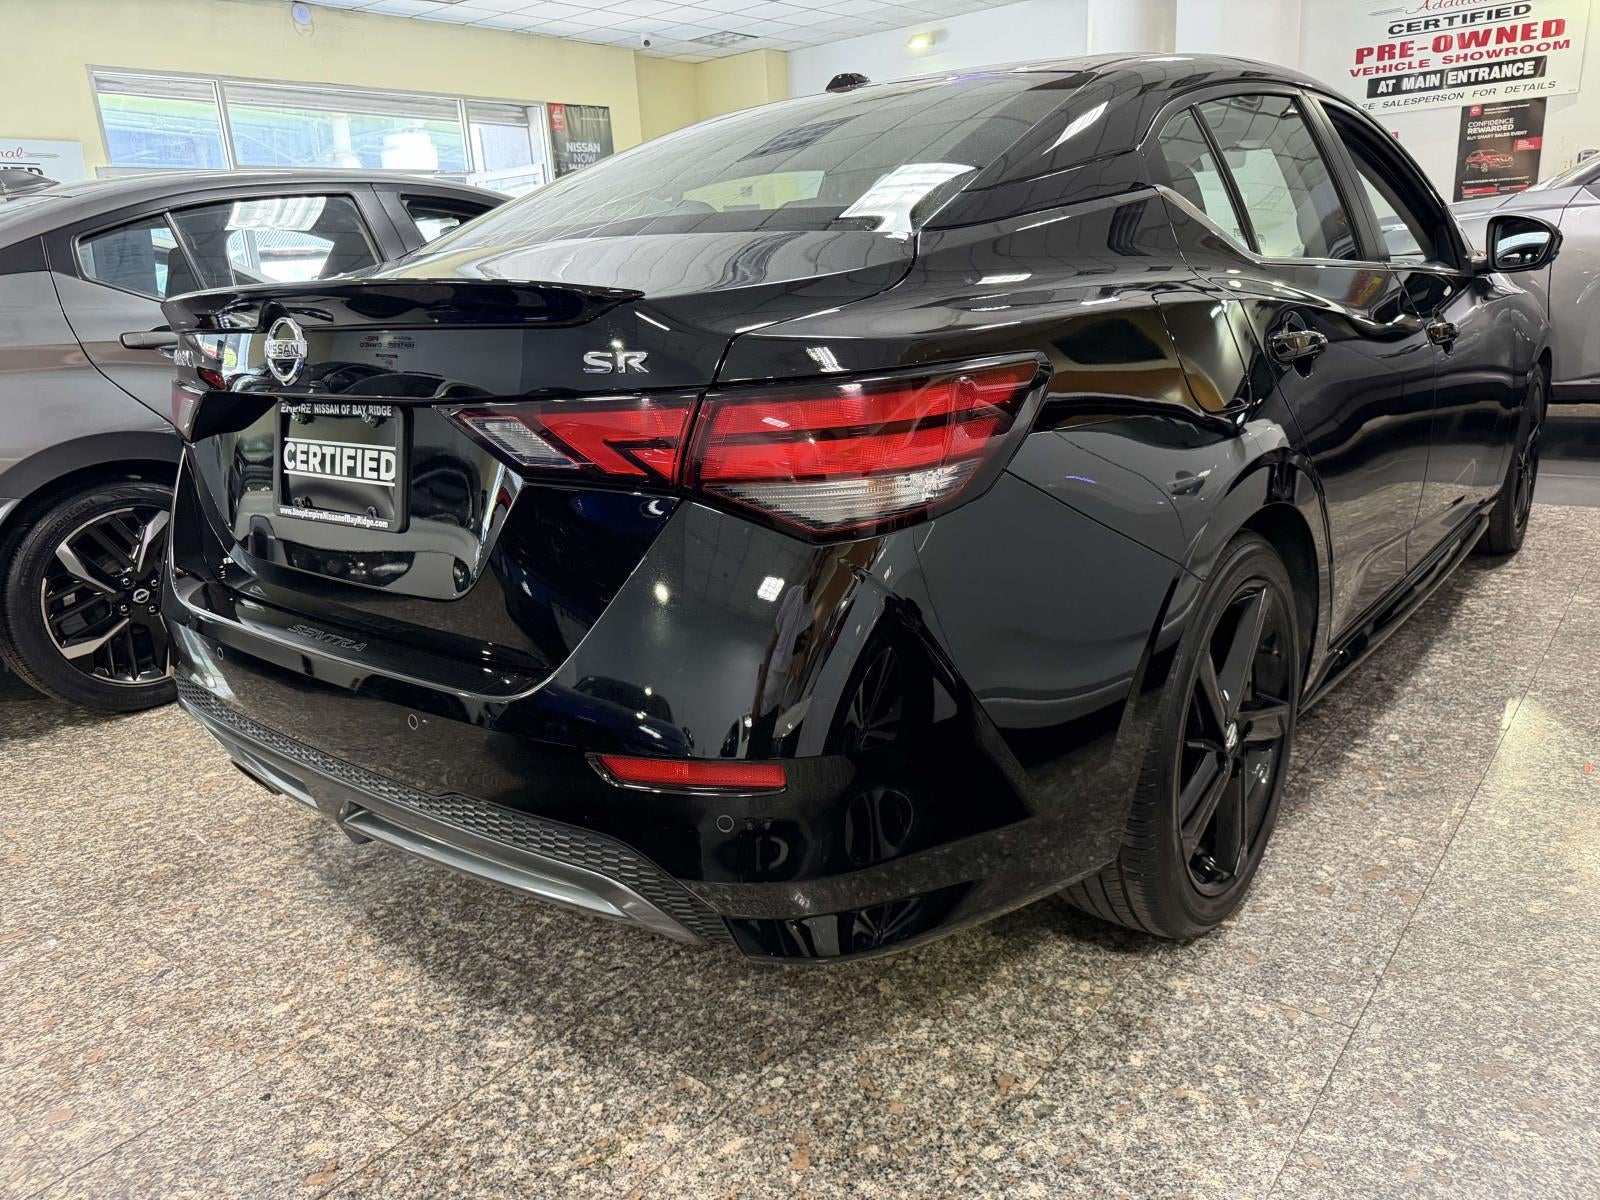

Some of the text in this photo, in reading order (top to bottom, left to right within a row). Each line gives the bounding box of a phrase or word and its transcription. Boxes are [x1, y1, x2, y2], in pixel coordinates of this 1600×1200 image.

[1388, 4, 1531, 35] CERTIFIED
[1355, 18, 1566, 65] PRE-OWNED
[1349, 39, 1571, 78] VEHICLE SHOWROOM
[1376, 61, 1535, 94] AT MAIN ENTRANCE
[1382, 92, 1464, 109] SALESPERSON
[1472, 88, 1497, 98] FOR
[1504, 81, 1556, 93] DETAILS
[1467, 117, 1515, 128] CONFIDENCE
[1467, 124, 1515, 135] REWARDED
[566, 142, 601, 153] NISSAN
[573, 153, 596, 163] NOW
[266, 342, 299, 355] NISSAN
[583, 351, 649, 373] SR
[313, 403, 340, 415] NISSAN
[341, 404, 351, 415] OF
[352, 404, 366, 416] BAY
[369, 405, 392, 417] RIDGE
[283, 442, 396, 481] CERTIFIED
[287, 624, 368, 652] SENTRA
